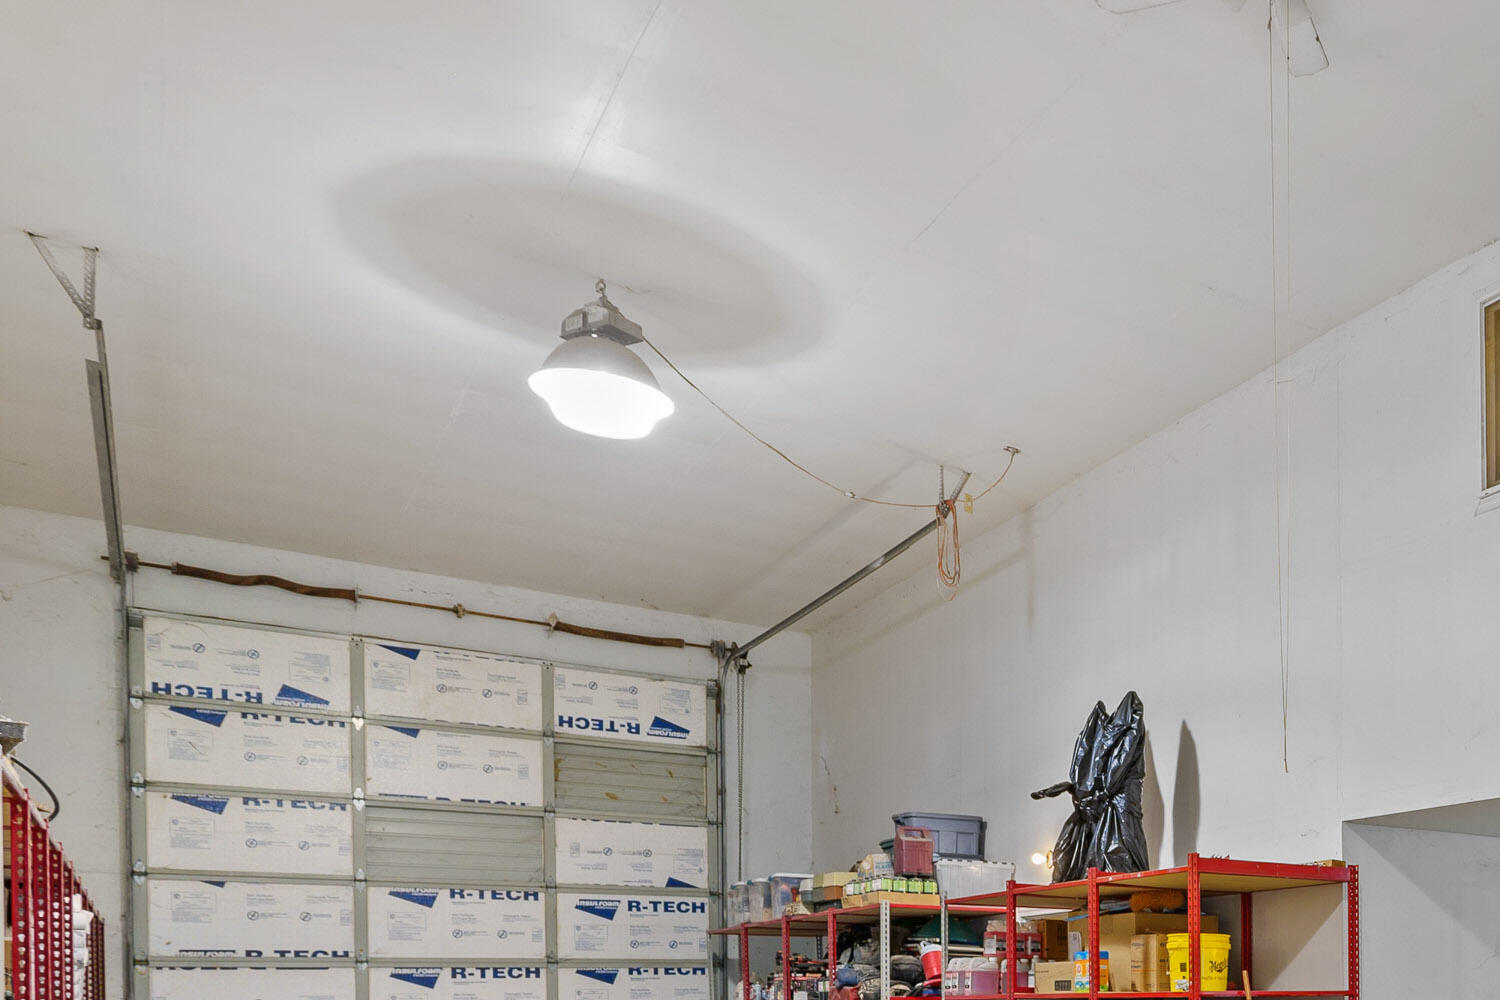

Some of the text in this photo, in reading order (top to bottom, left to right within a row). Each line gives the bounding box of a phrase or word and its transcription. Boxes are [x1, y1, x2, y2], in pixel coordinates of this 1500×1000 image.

[151, 681, 263, 704] R-TECH
[558, 715, 640, 735] R-TECH
[450, 888, 540, 901] R-TECH
[627, 900, 706, 914] R-TECH
[451, 967, 541, 979] R-TECH
